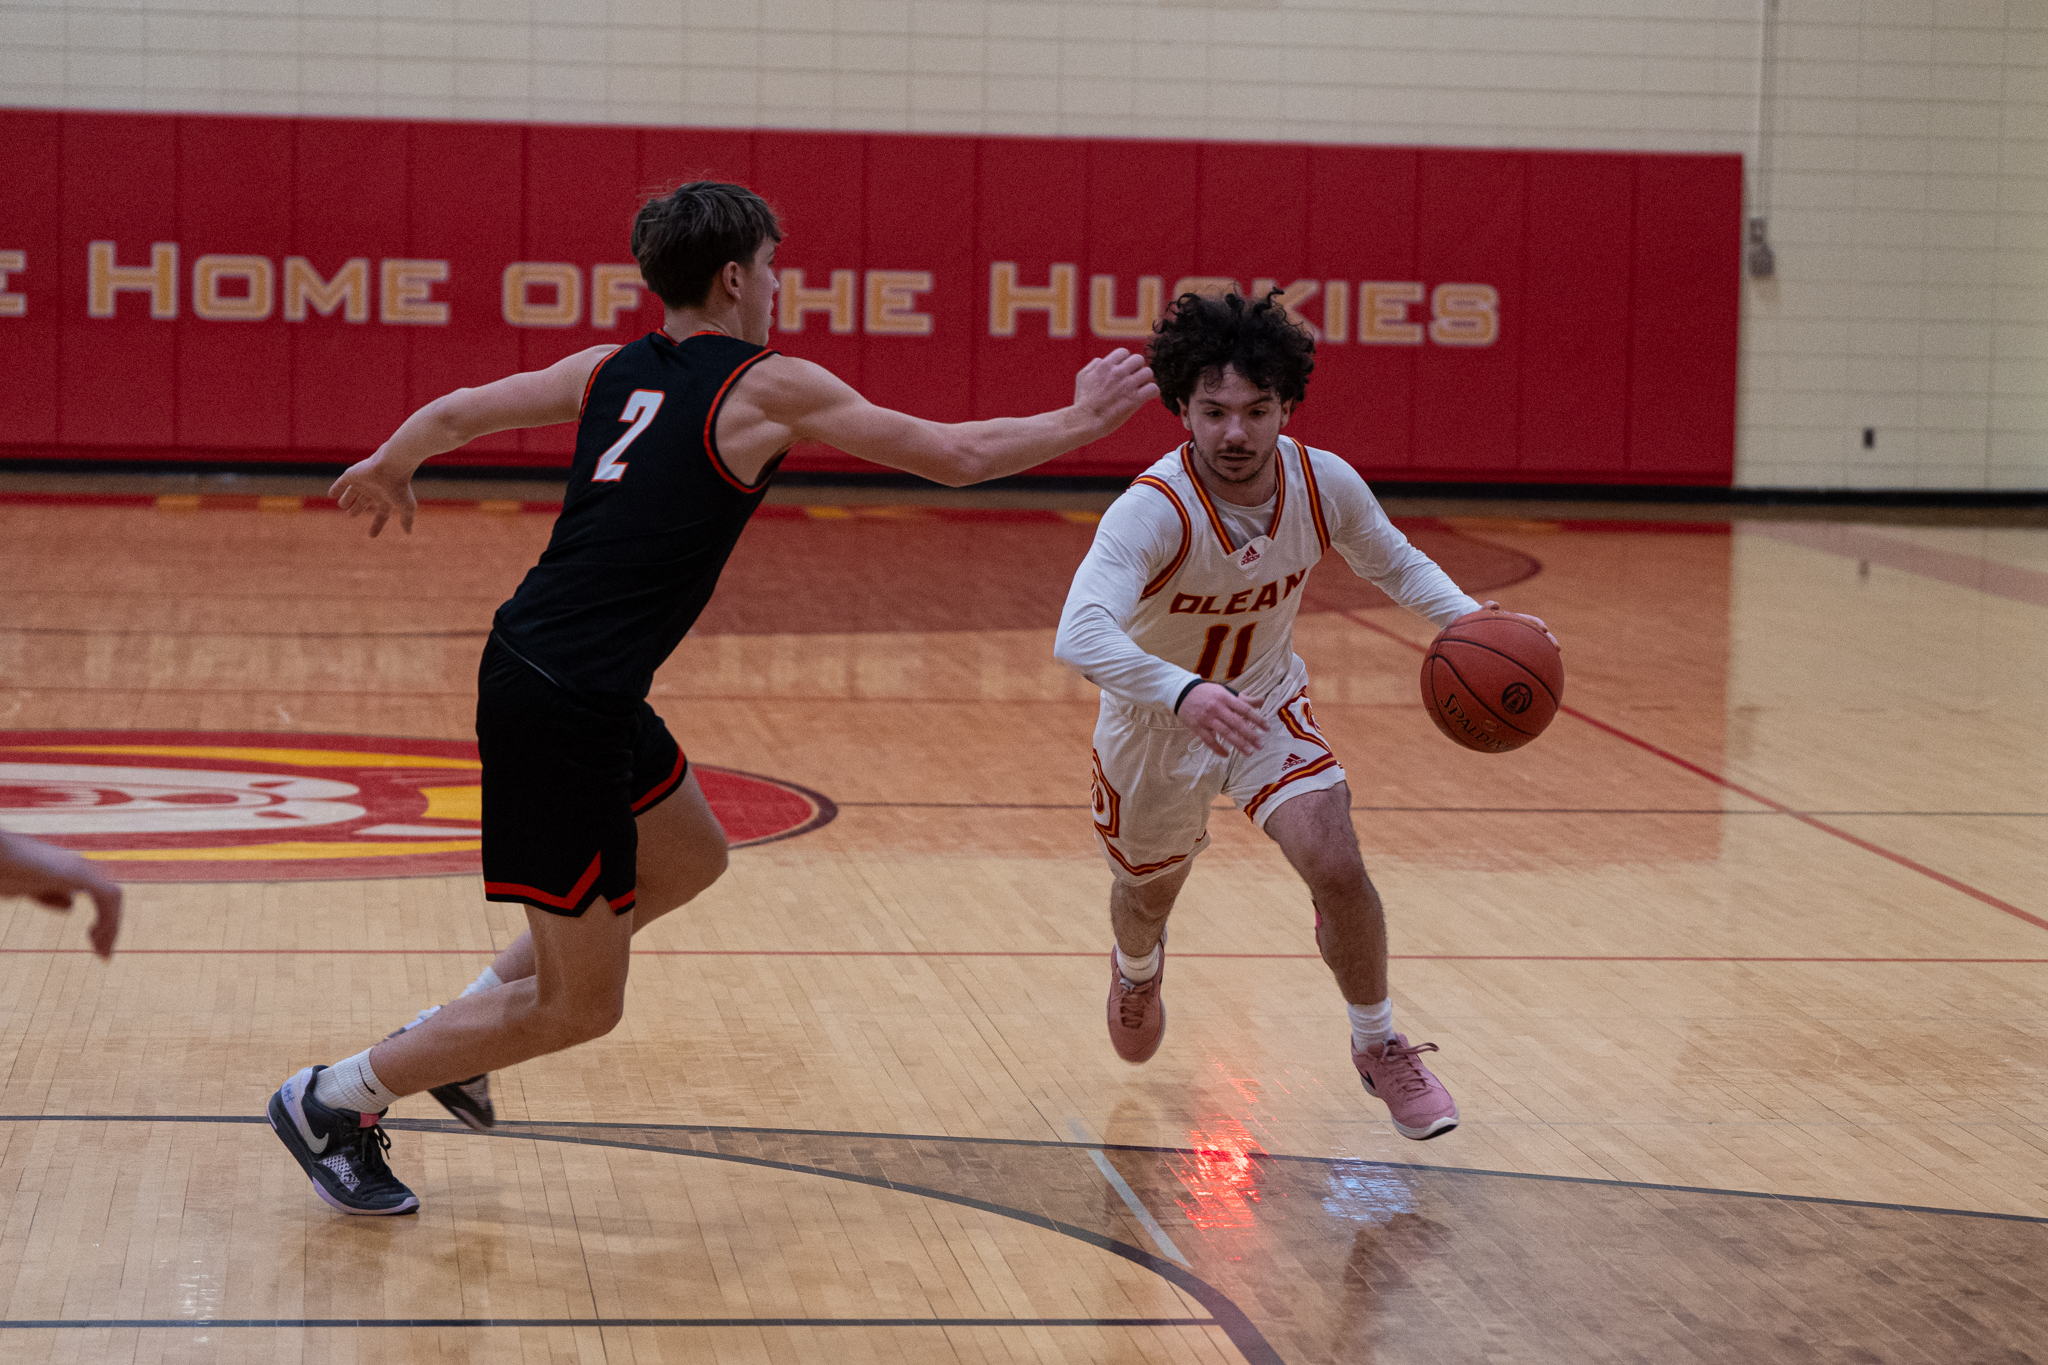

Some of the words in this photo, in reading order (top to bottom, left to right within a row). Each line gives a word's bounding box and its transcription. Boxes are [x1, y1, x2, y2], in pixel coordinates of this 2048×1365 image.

[503, 262, 645, 328] OF
[777, 267, 934, 334] HE
[591, 389, 665, 482] 2
[1241, 553, 1260, 566] adidas
[1169, 567, 1308, 615] OLEAN
[1194, 621, 1258, 680] 11
[1281, 758, 1307, 771] adidas
